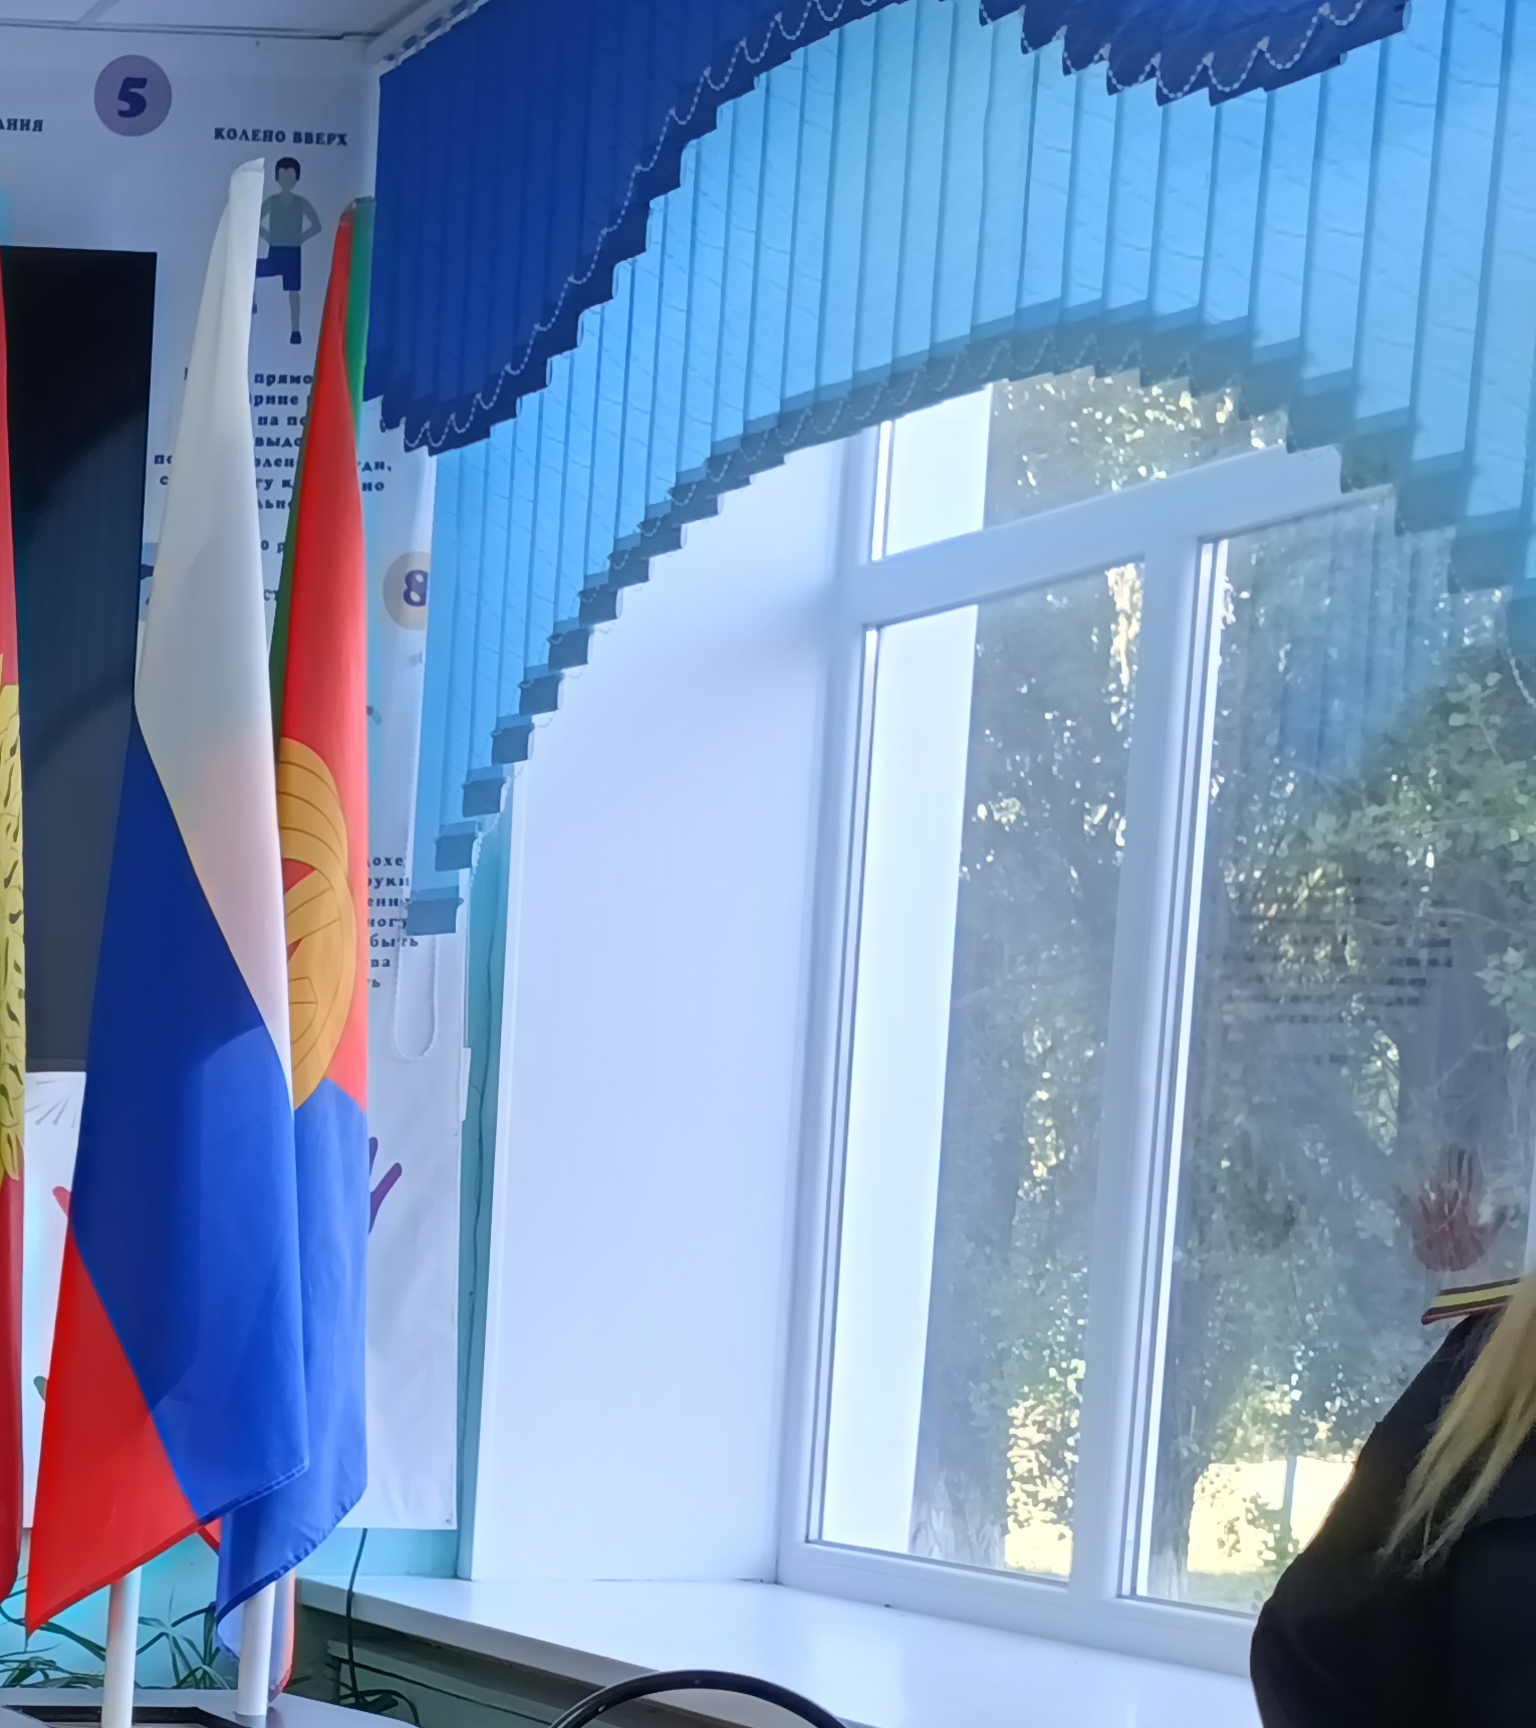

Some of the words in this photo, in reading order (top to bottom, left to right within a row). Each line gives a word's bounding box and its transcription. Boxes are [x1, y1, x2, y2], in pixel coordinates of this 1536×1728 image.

[117, 77, 148, 118] 5
[214, 127, 287, 145] КОЛЕНО
[292, 131, 348, 147] ВВЕРХ
